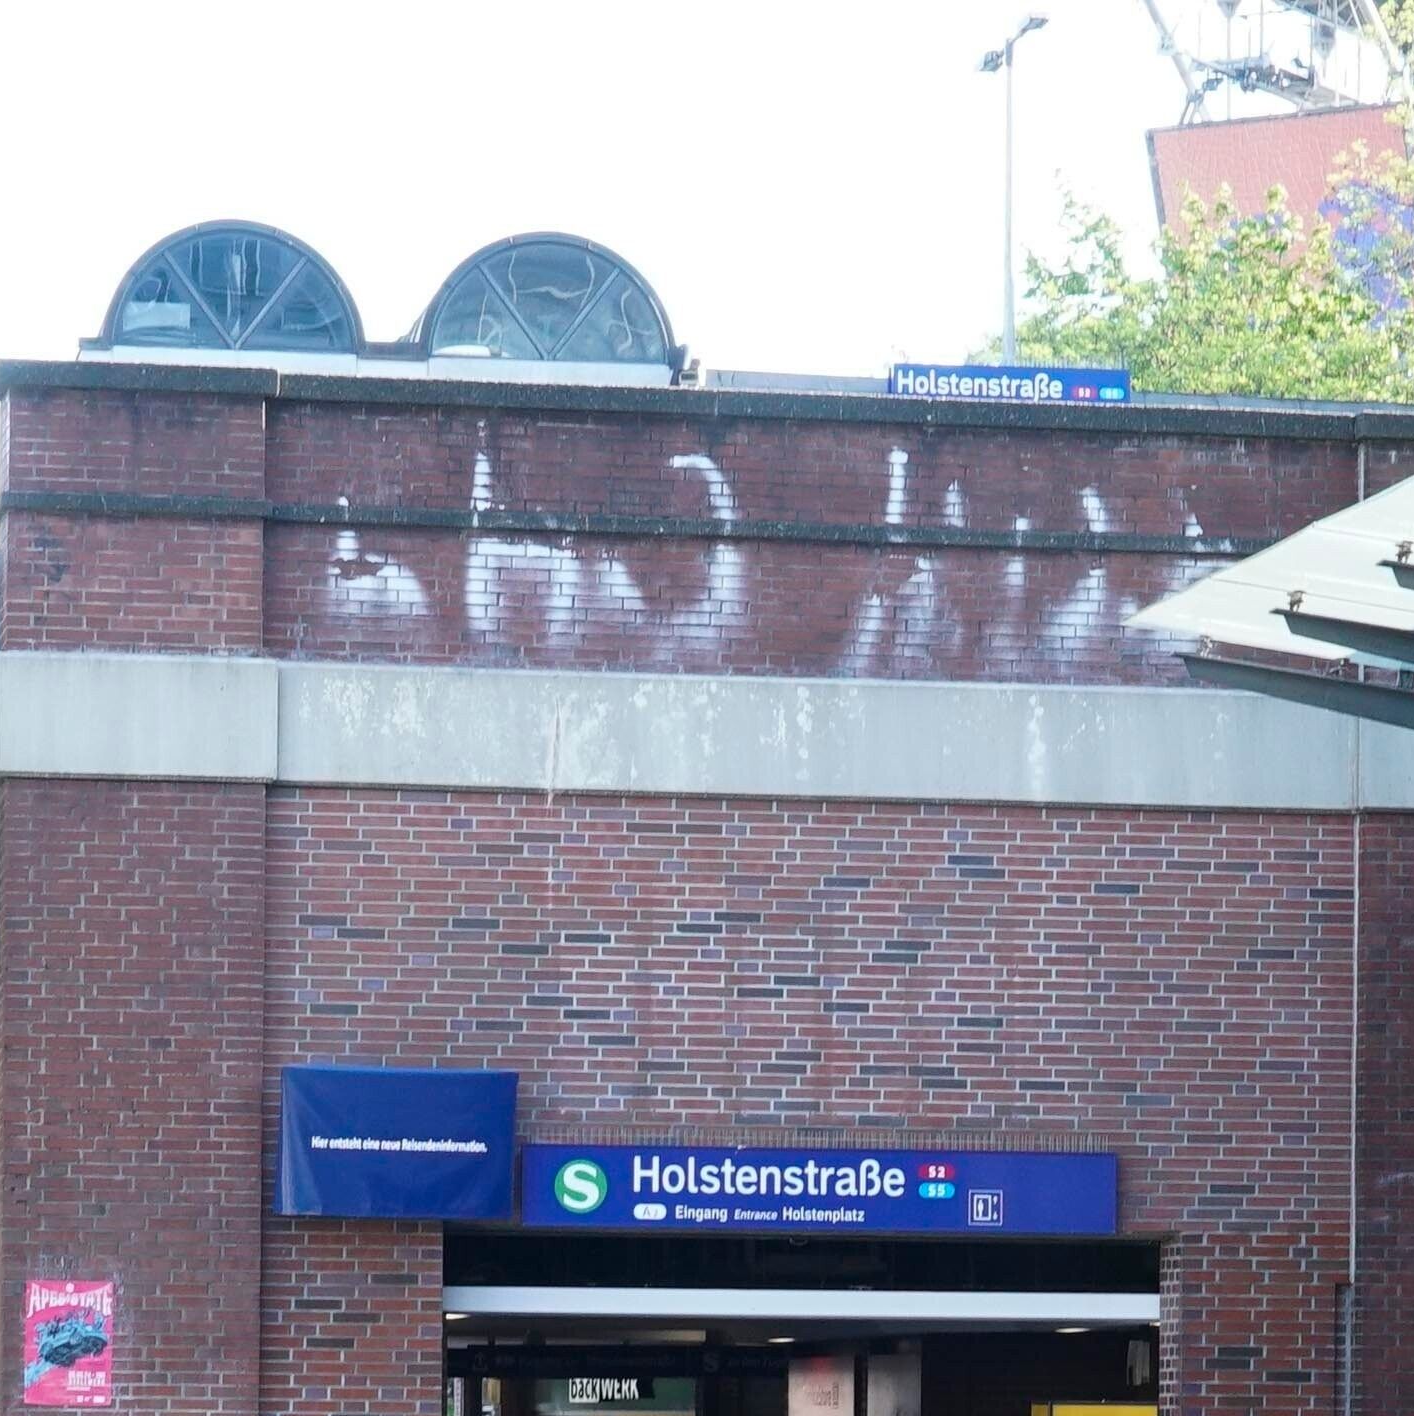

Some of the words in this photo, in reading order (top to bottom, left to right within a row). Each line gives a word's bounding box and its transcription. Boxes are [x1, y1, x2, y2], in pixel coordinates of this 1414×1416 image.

[897, 369, 1063, 402] Holstenstraße
[312, 1136, 328, 1149] Hier
[330, 1136, 362, 1150] entsteht
[363, 1137, 379, 1150] eine
[381, 1139, 400, 1151] neue
[633, 1156, 905, 1197] Holstenstraße
[927, 1165, 946, 1179] S2
[561, 1162, 601, 1211] S
[675, 1204, 728, 1223] Eingang
[734, 1208, 778, 1221] Entrance
[782, 1206, 865, 1223] Holstenplatz
